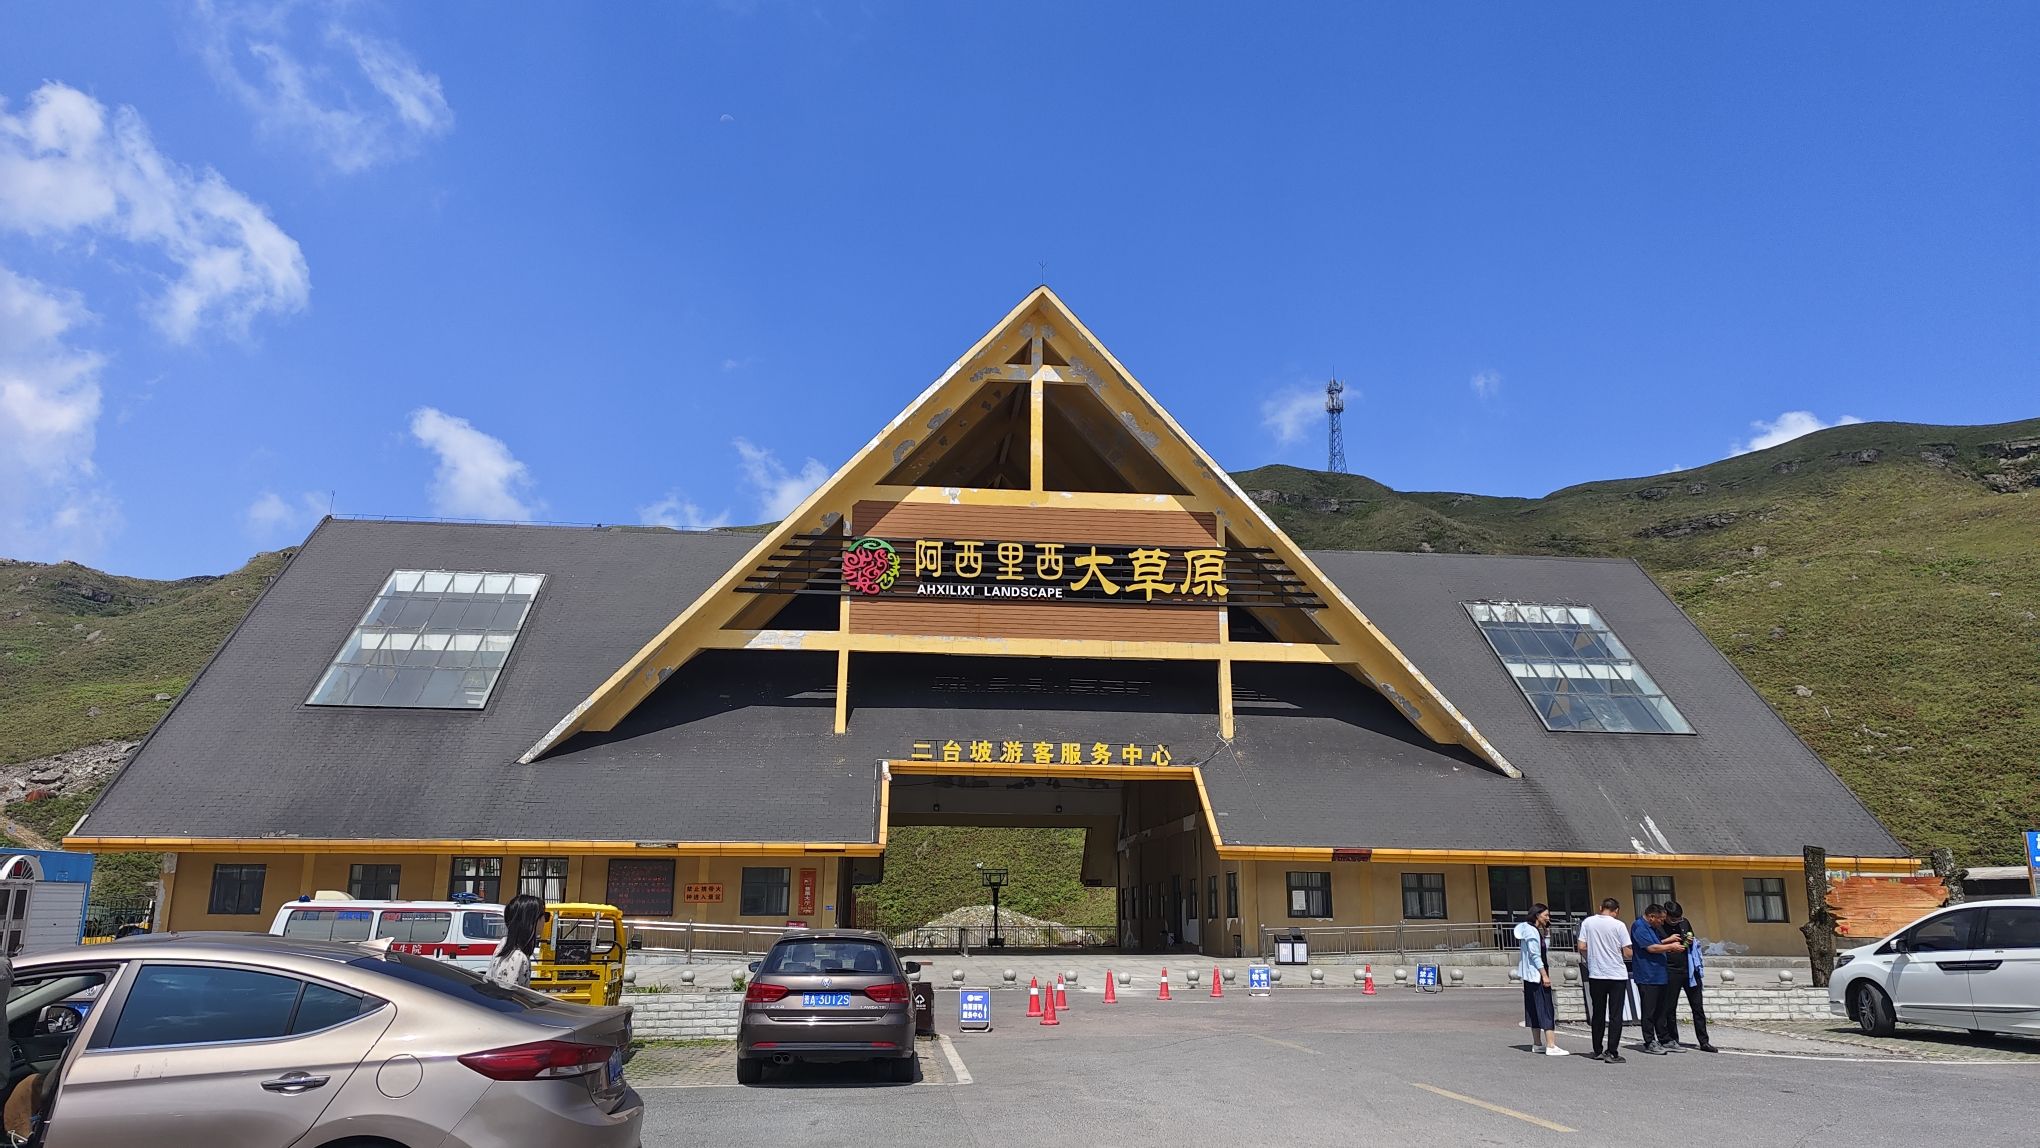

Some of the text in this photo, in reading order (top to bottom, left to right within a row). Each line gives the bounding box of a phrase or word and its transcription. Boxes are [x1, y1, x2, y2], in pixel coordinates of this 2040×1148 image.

[916, 584, 1063, 598] AHXILIXI LANDSCAPE
[911, 739, 1172, 766] 二台坡游客服务中心
[1252, 973, 1268, 981] 检票
